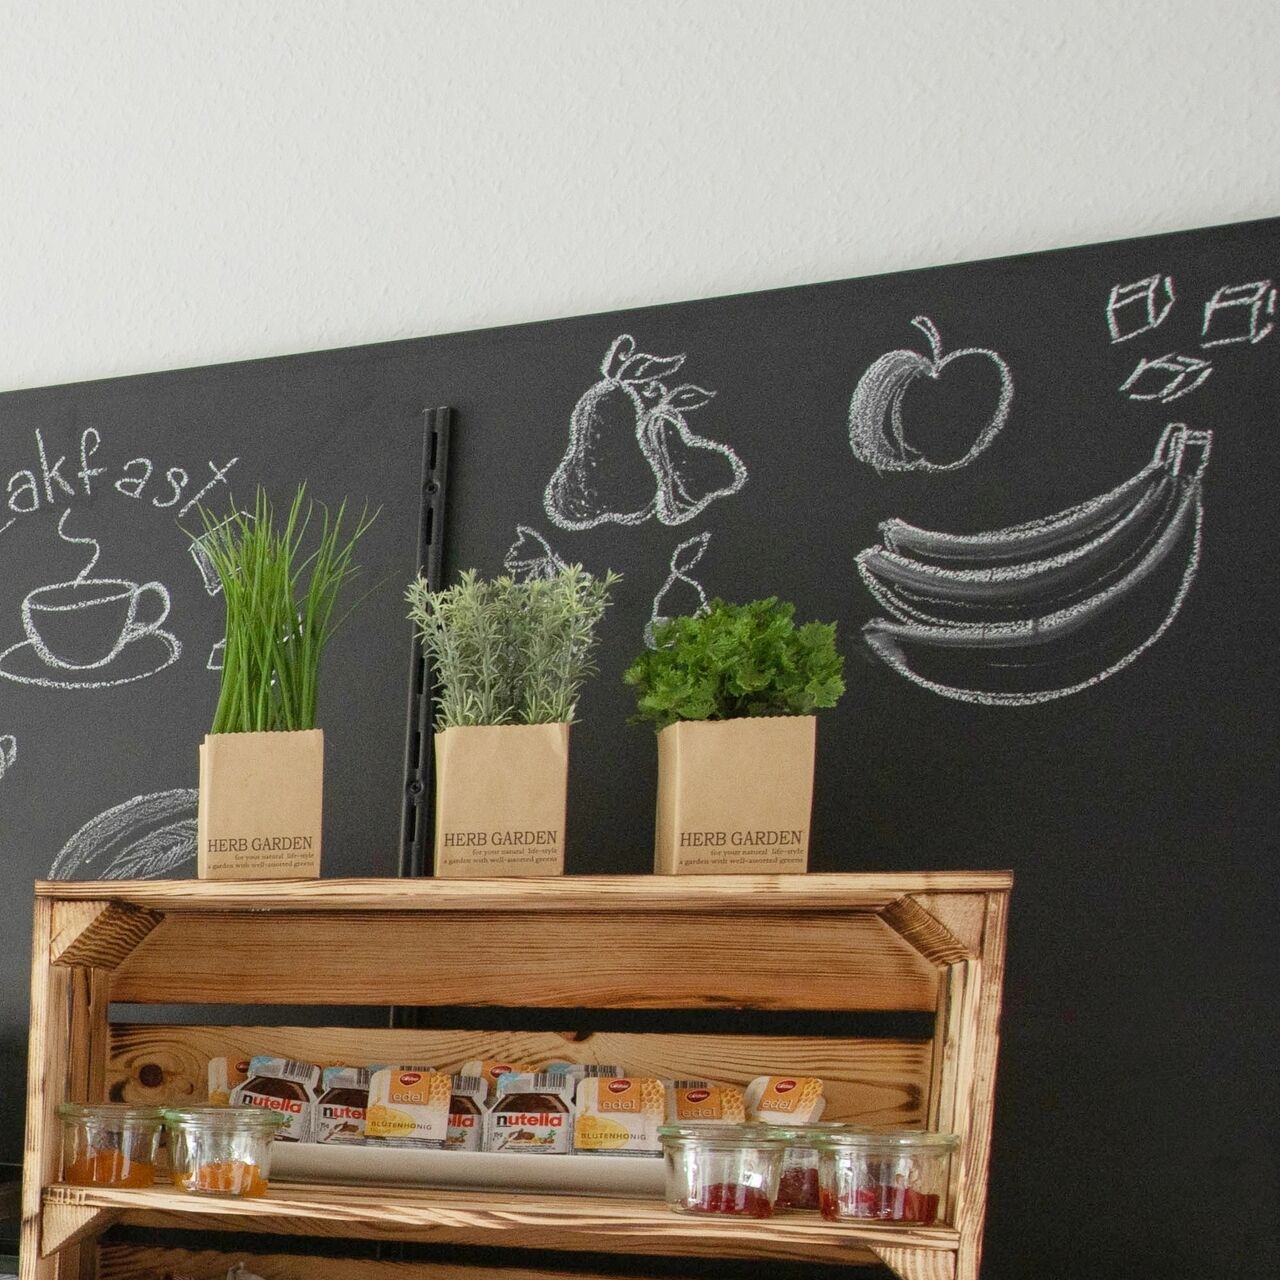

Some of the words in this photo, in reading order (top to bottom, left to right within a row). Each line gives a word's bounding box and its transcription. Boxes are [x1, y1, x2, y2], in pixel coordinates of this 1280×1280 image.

[208, 838, 248, 852] HERB
[251, 836, 312, 851] GARDEN
[444, 832, 487, 846] HERB
[491, 831, 558, 845] GARDEN
[680, 832, 727, 847] HERB
[731, 830, 803, 845] GARDEN
[241, 1094, 302, 1113] nutella
[602, 1099, 636, 1110] edel
[762, 1099, 793, 1110] edel
[322, 1106, 367, 1121] nutel
[496, 1112, 562, 1128] nutella
